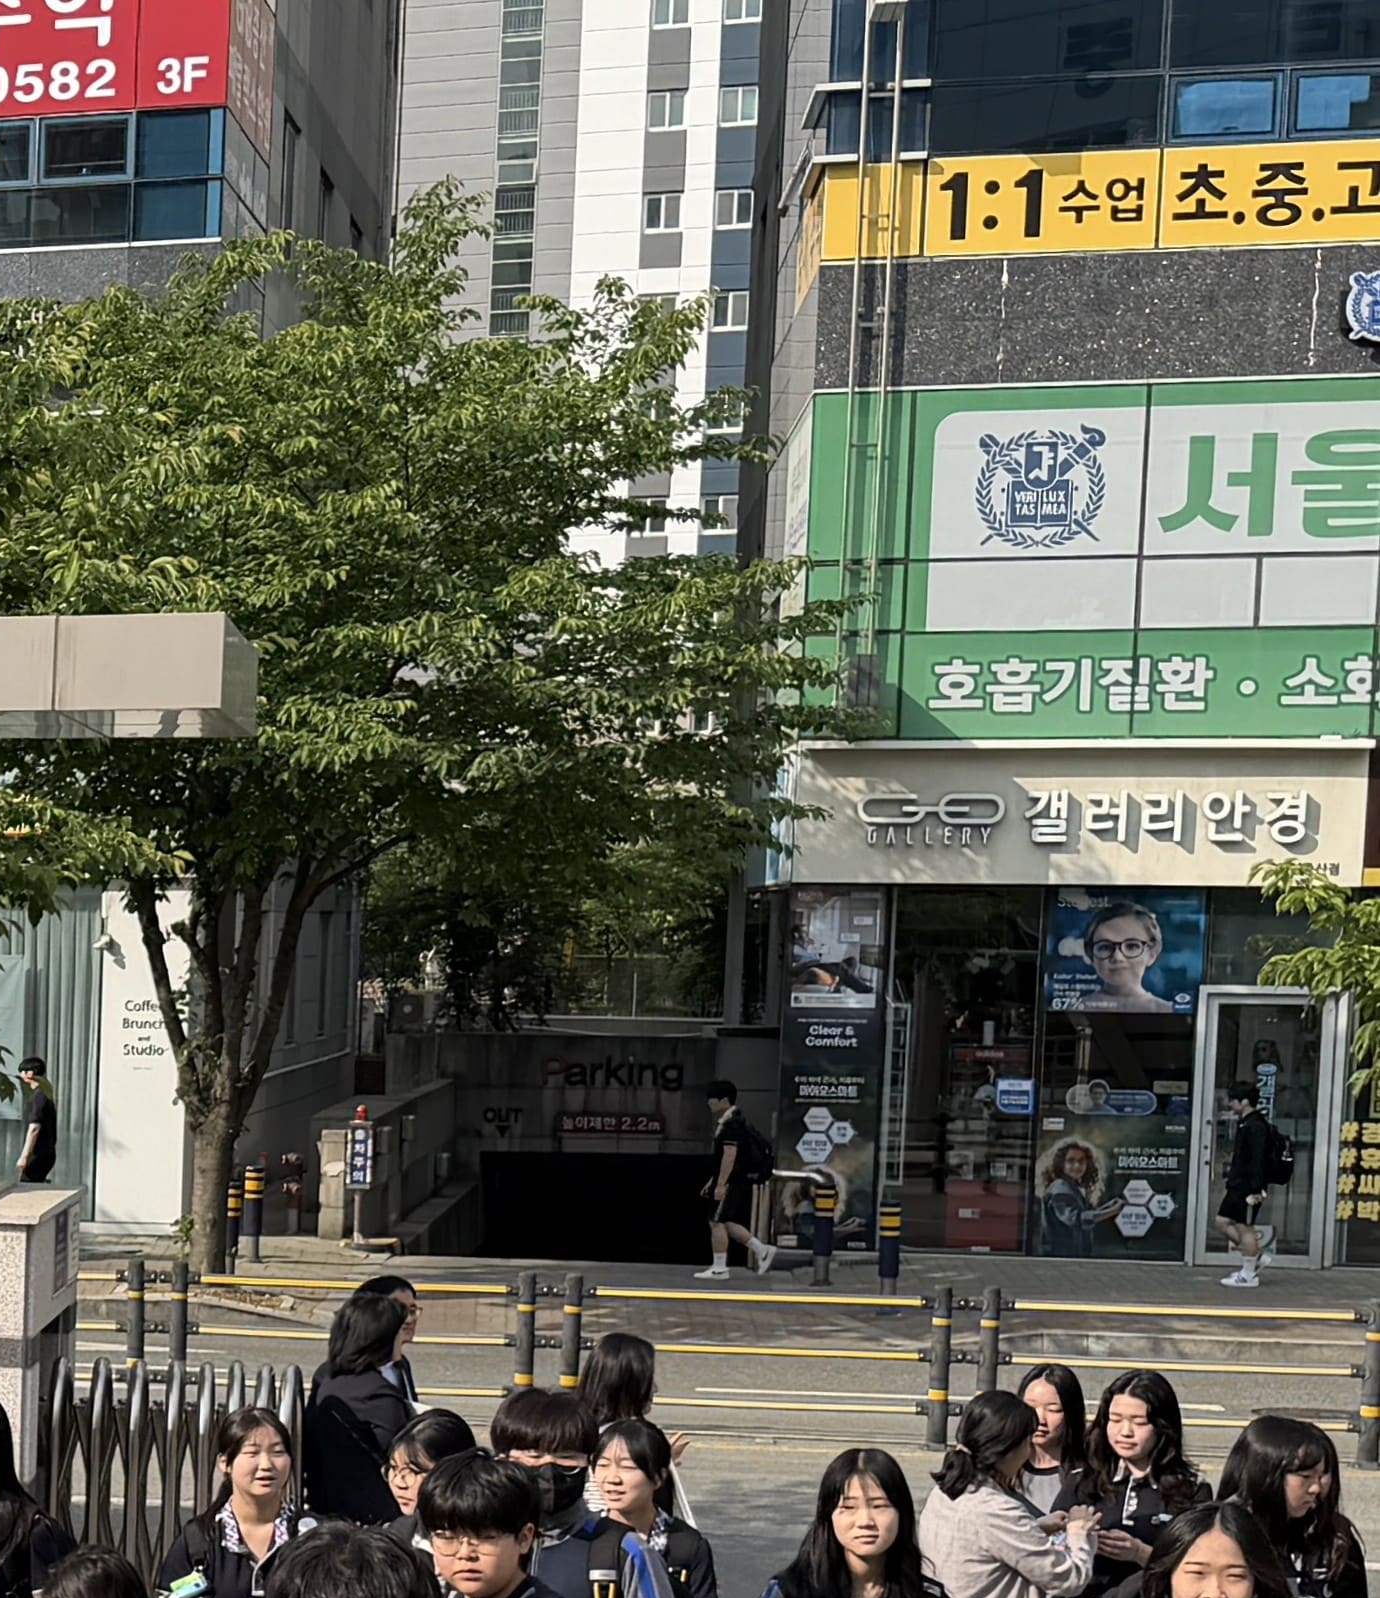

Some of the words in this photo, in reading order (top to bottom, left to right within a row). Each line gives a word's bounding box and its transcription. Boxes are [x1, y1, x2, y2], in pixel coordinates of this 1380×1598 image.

[156, 55, 210, 96] 3F
[939, 168, 1041, 241] 1:1
[1058, 177, 1145, 224] 수업
[1158, 430, 1380, 540] 서울
[1043, 490, 1066, 503] LUX
[1015, 504, 1036, 516] TAS
[1041, 503, 1067, 515] MEA
[928, 655, 1212, 714] 호흡기질환
[1024, 788, 1309, 845] 갤러리안경
[867, 826, 992, 846] GALLERY
[1051, 997, 1085, 1011] 67%
[809, 1024, 843, 1036] Clear
[845, 1025, 856, 1036] &
[123, 1043, 165, 1056] Studio
[805, 1036, 858, 1048] Comfort
[542, 1055, 685, 1092] Parking
[483, 1107, 523, 1124] OUT
[562, 1115, 616, 1131] 높이제한
[620, 1115, 661, 1131] 2.2m
